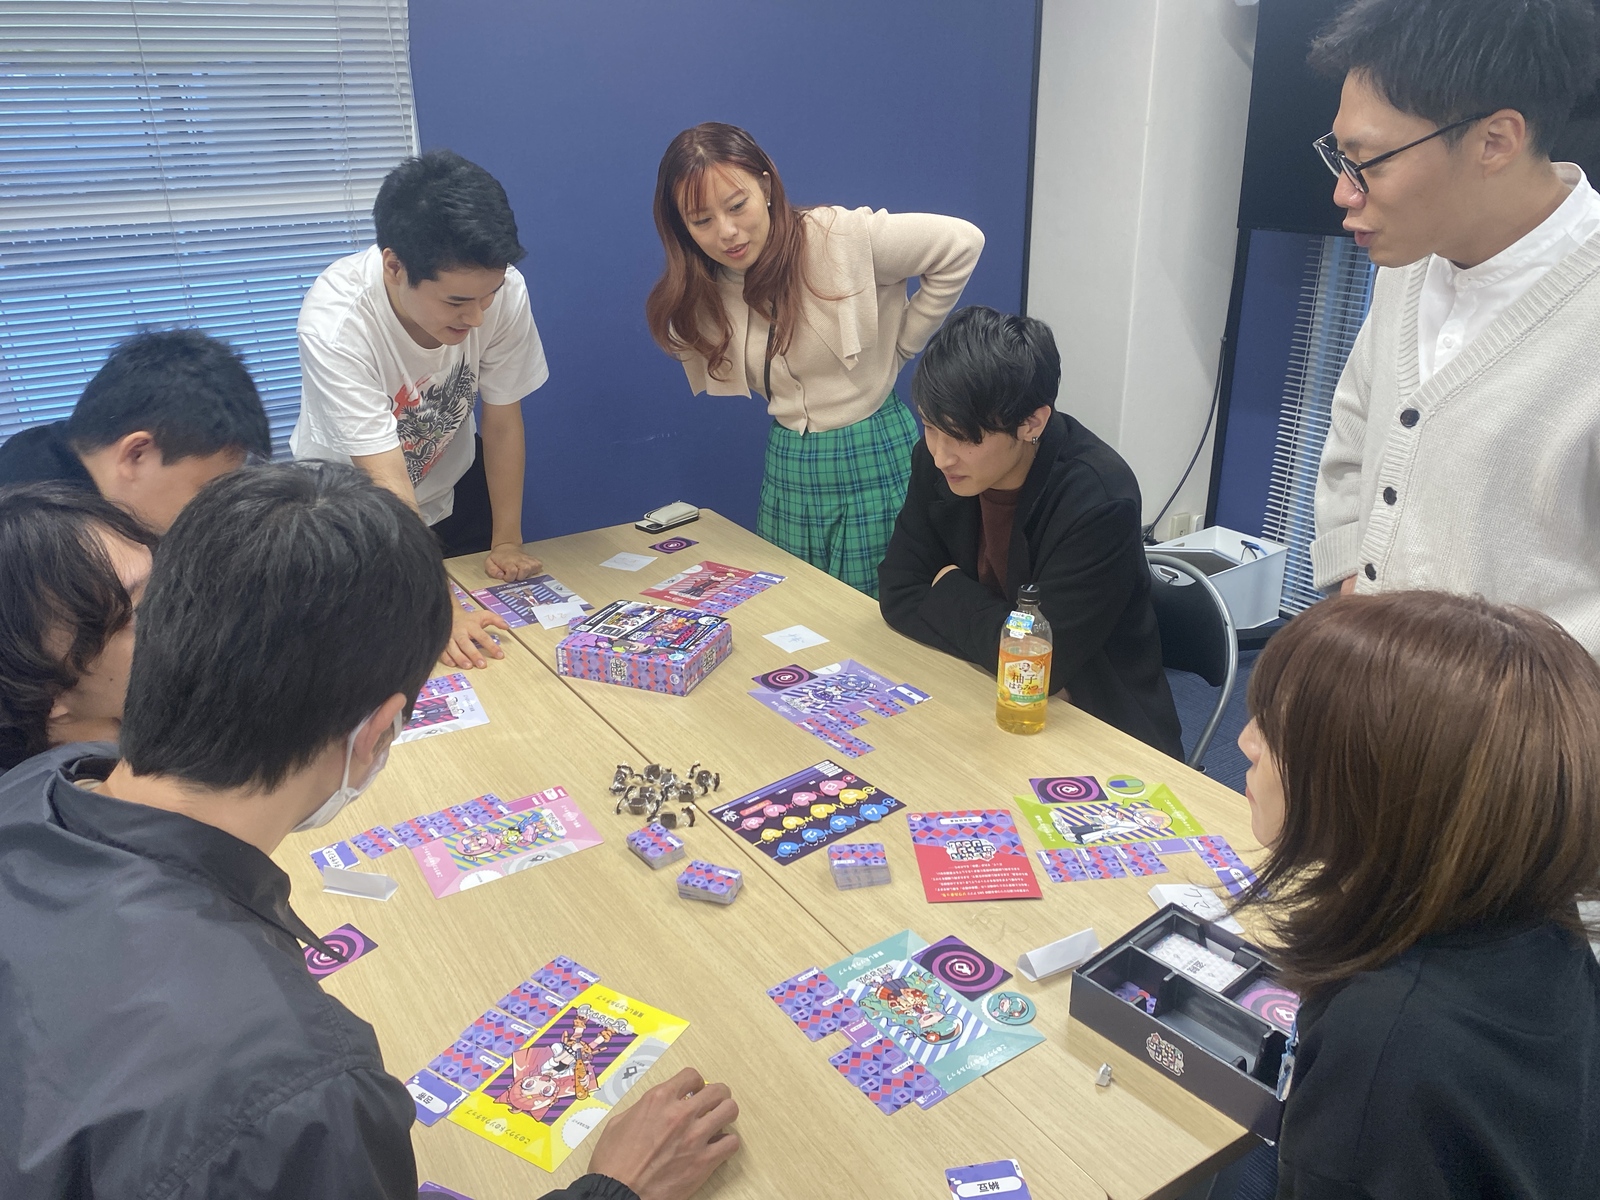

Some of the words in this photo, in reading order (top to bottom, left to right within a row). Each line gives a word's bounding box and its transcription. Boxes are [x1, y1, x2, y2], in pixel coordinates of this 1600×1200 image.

[1009, 682, 1039, 691] はちみつ
[977, 1181, 1000, 1192] 納豆
